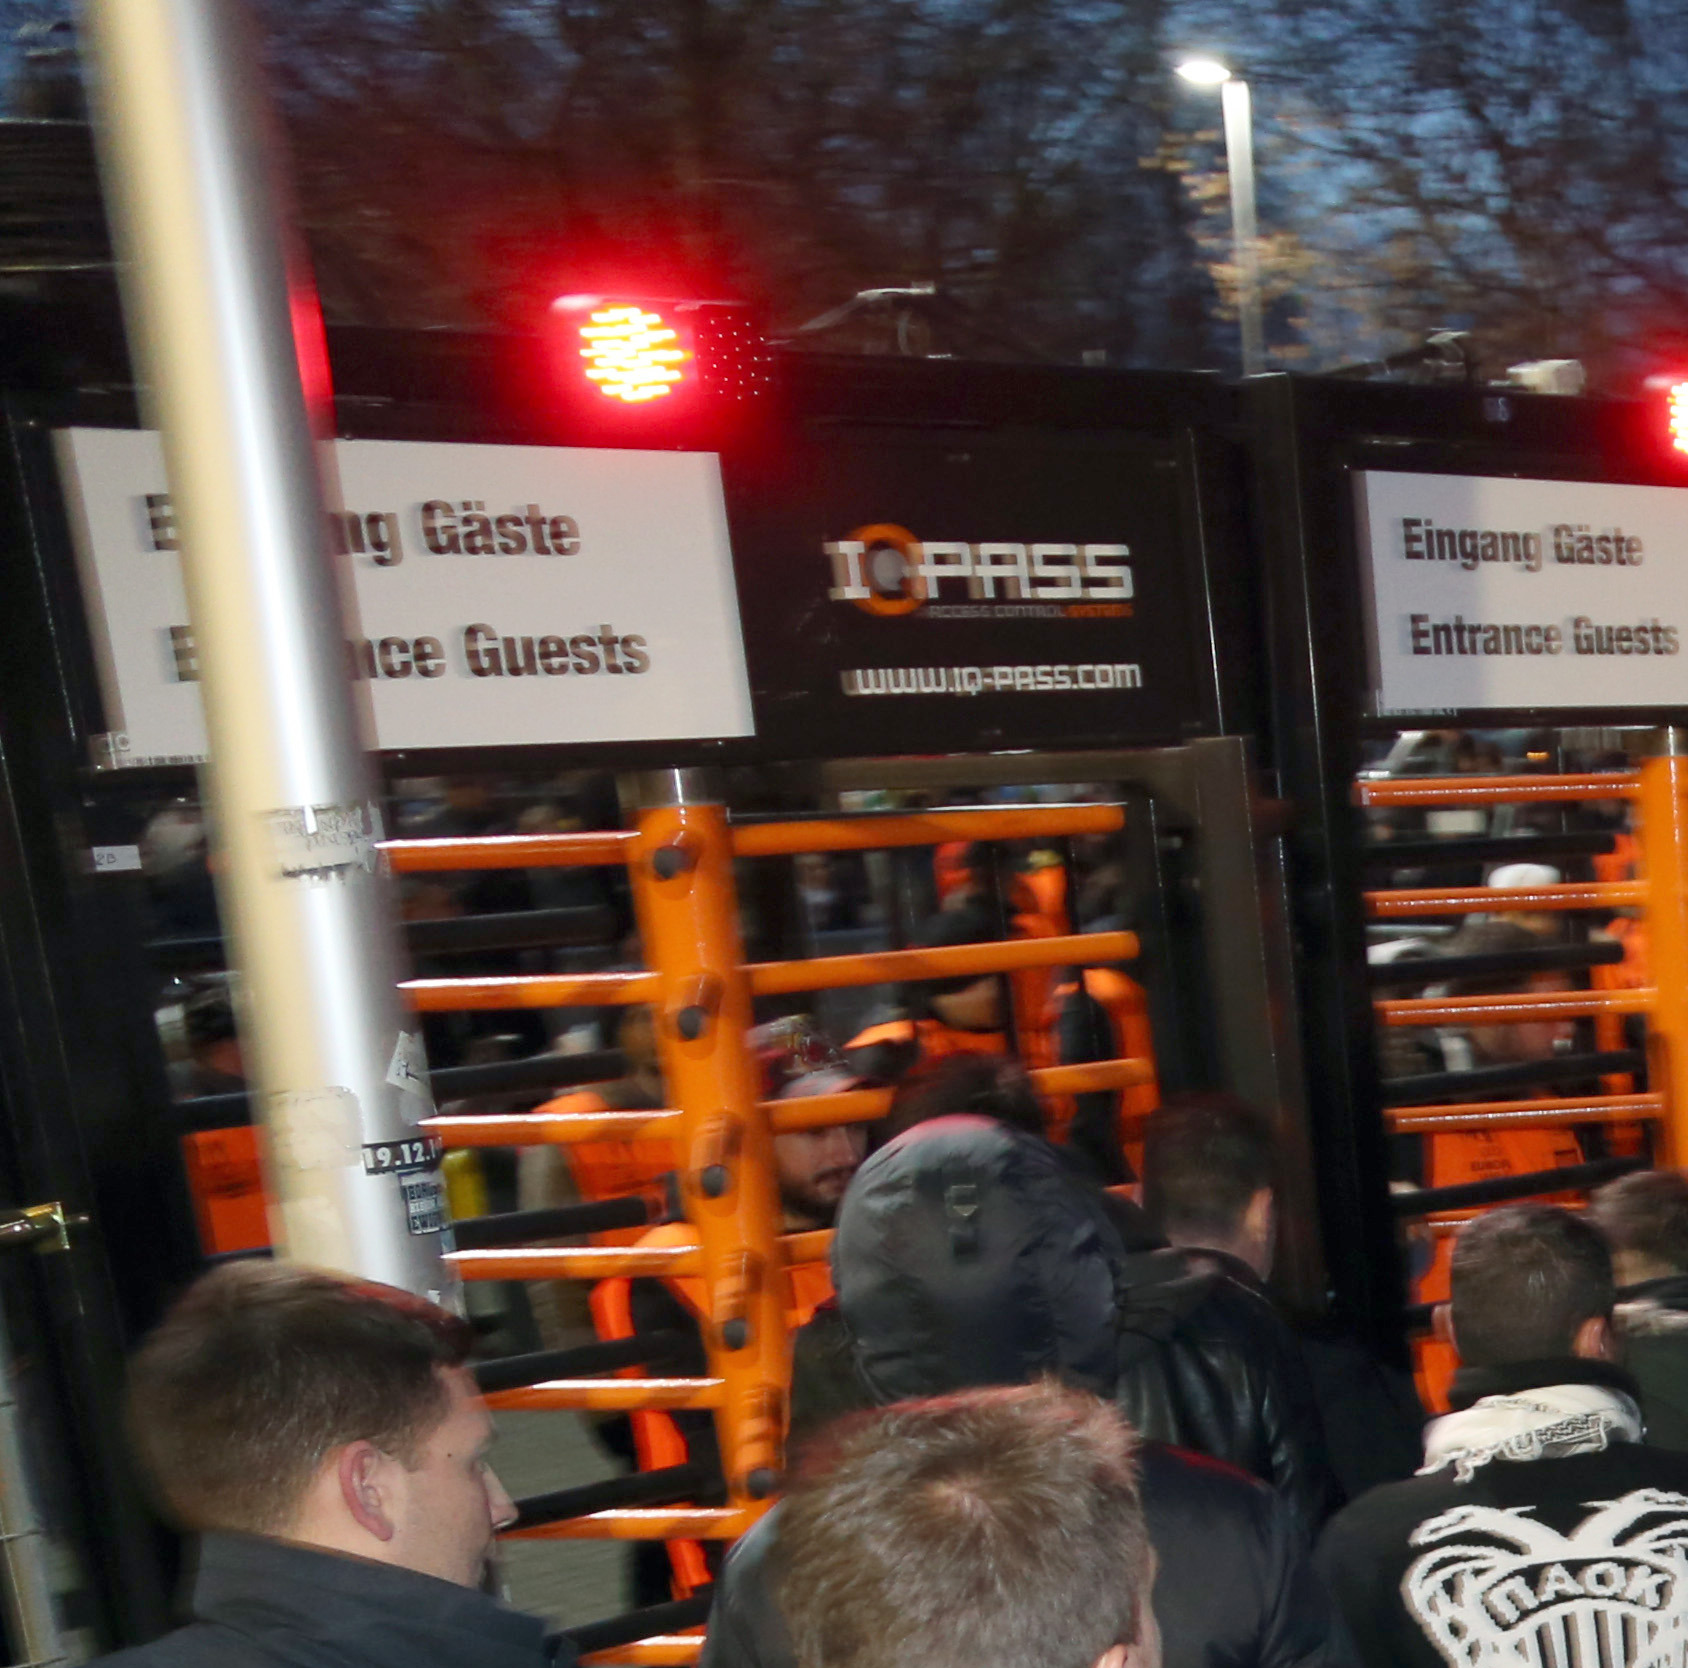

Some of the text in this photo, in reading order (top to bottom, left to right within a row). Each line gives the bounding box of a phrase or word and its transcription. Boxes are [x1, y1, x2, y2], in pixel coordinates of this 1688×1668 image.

[420, 497, 582, 558] Gäste
[1402, 517, 1644, 572] Eingang Gäste
[463, 622, 650, 678] Guests
[1409, 613, 1681, 658] Entrance Guests
